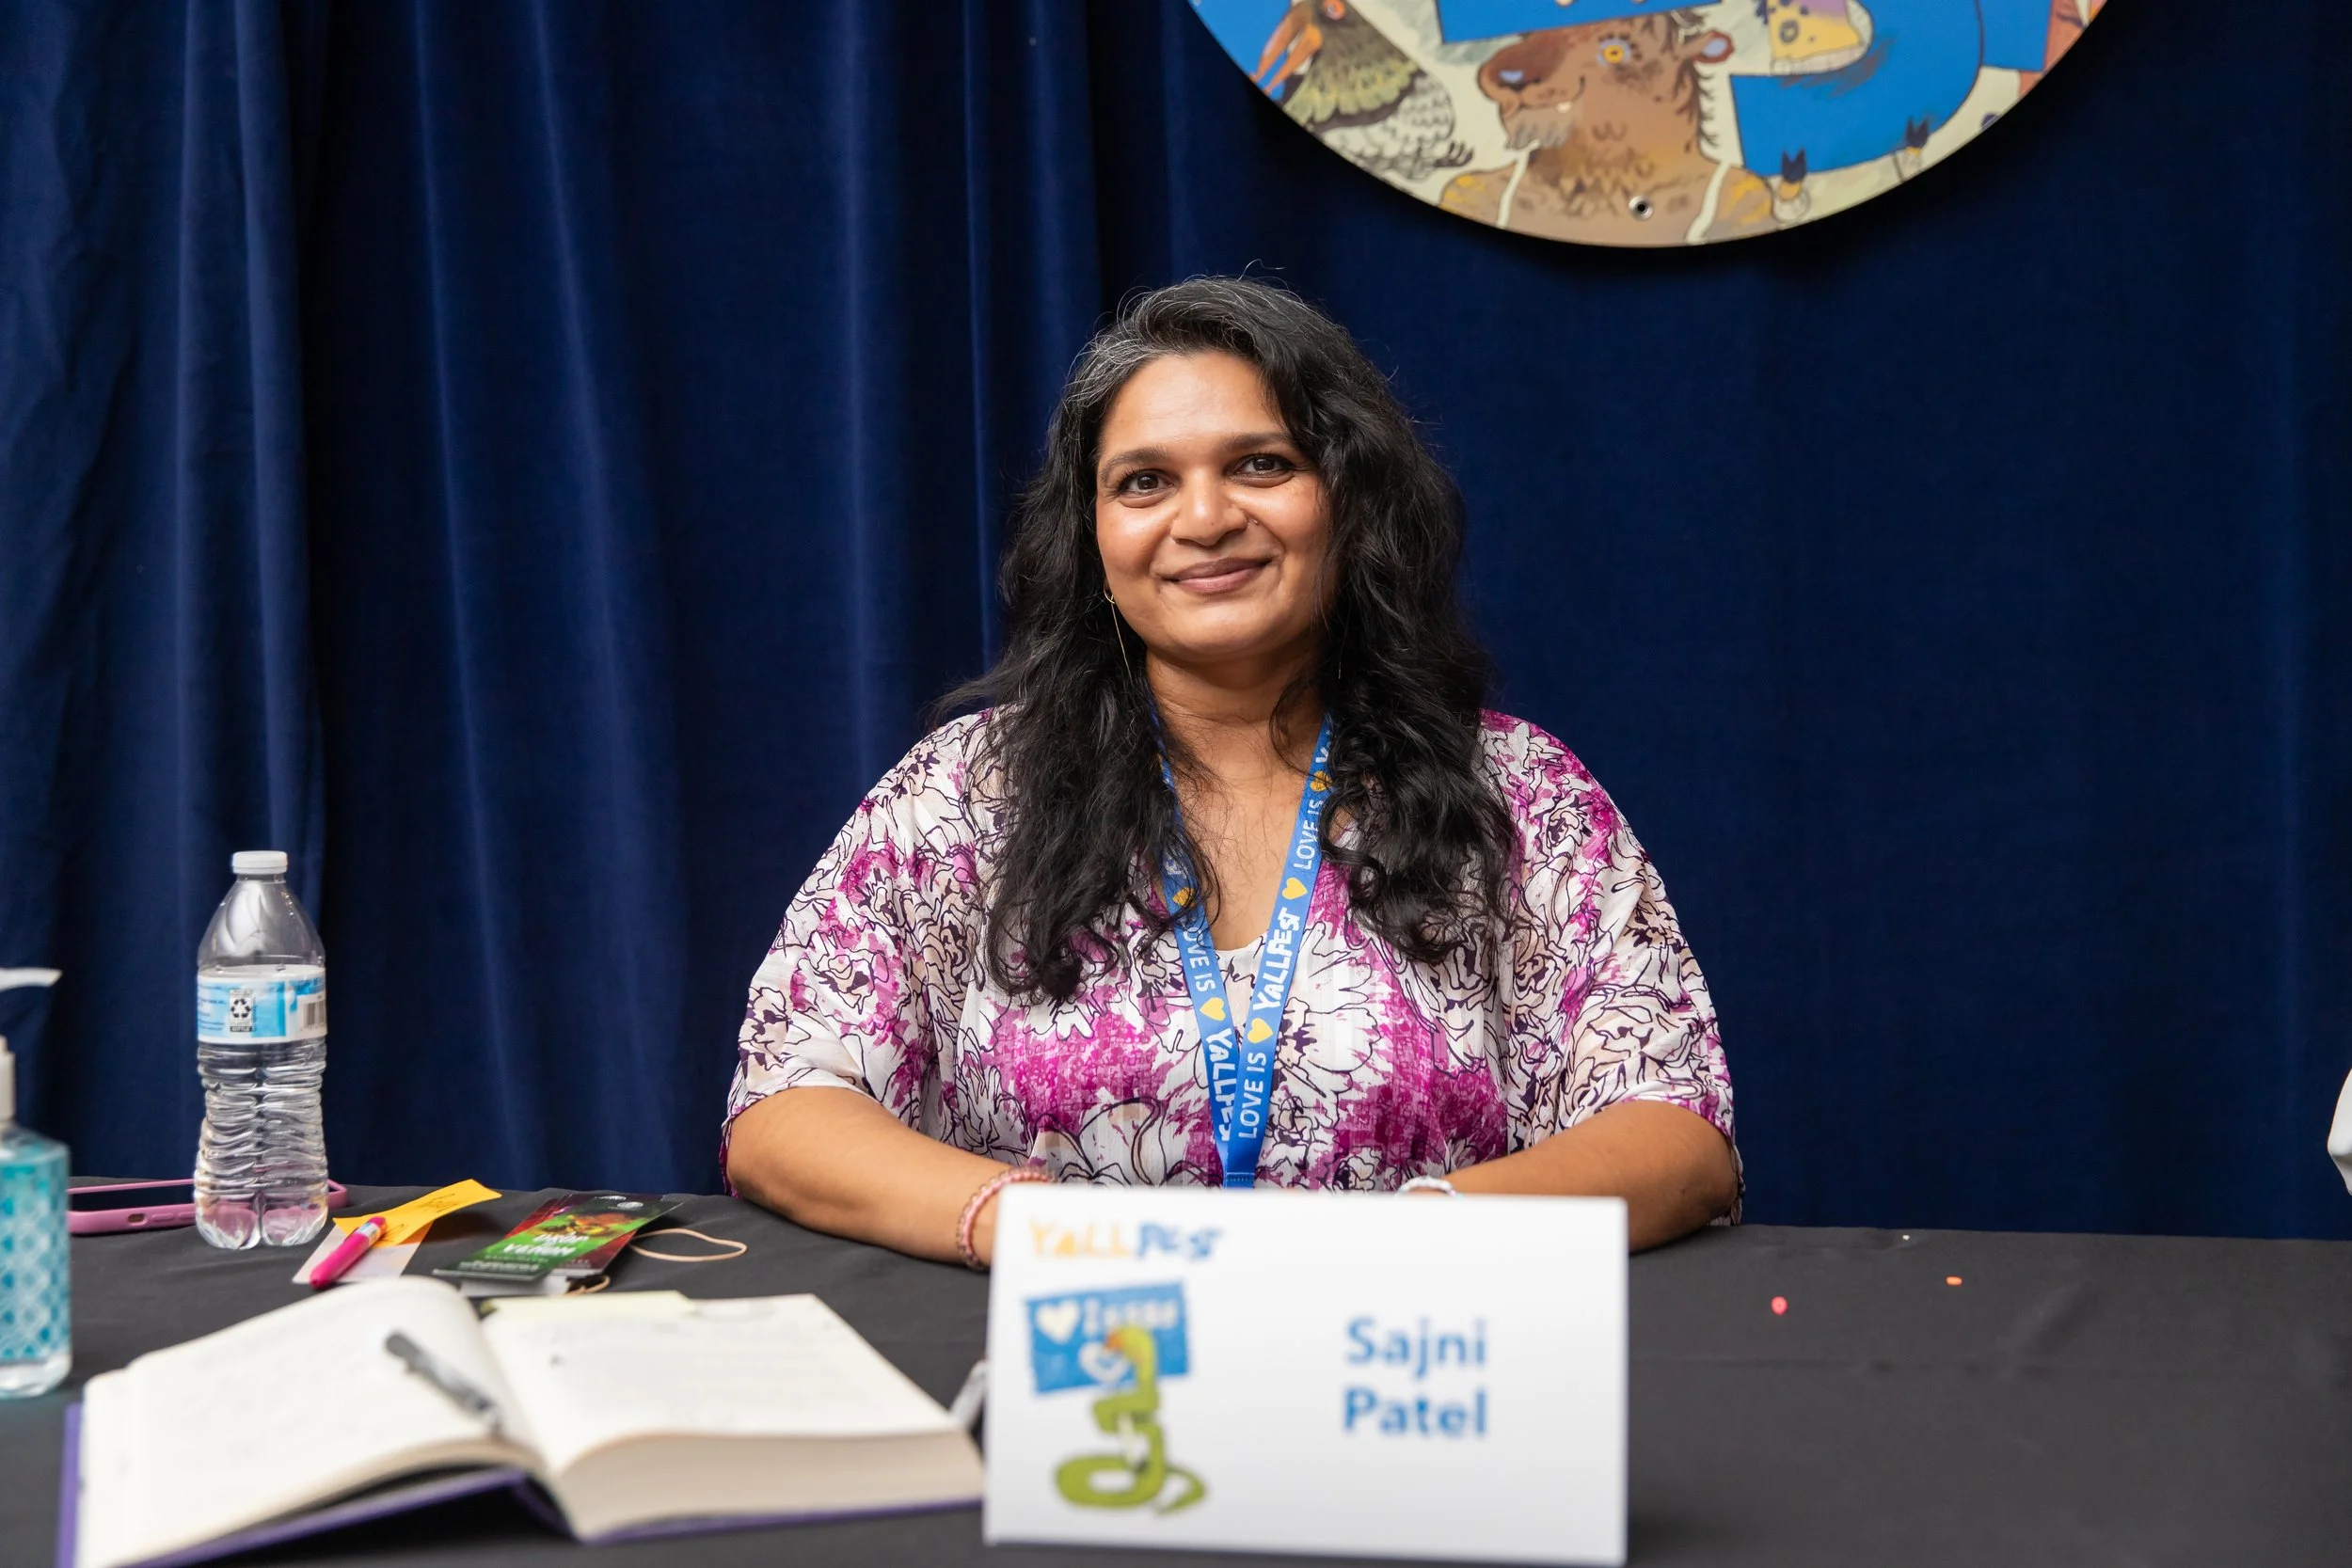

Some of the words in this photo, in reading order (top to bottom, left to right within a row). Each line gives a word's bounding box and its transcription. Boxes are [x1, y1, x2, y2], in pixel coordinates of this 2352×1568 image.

[1293, 819, 1319, 870] LOVE
[1180, 913, 1210, 969] OVE
[1252, 906, 1300, 1011] YALLFEST
[1194, 973, 1216, 992] IS
[1205, 1027, 1236, 1142] YALLFE
[1247, 1052, 1267, 1072] IS
[1238, 1079, 1264, 1139] LOVE
[1346, 1316, 1486, 1379] Sajni
[1344, 1386, 1486, 1436] Patel
